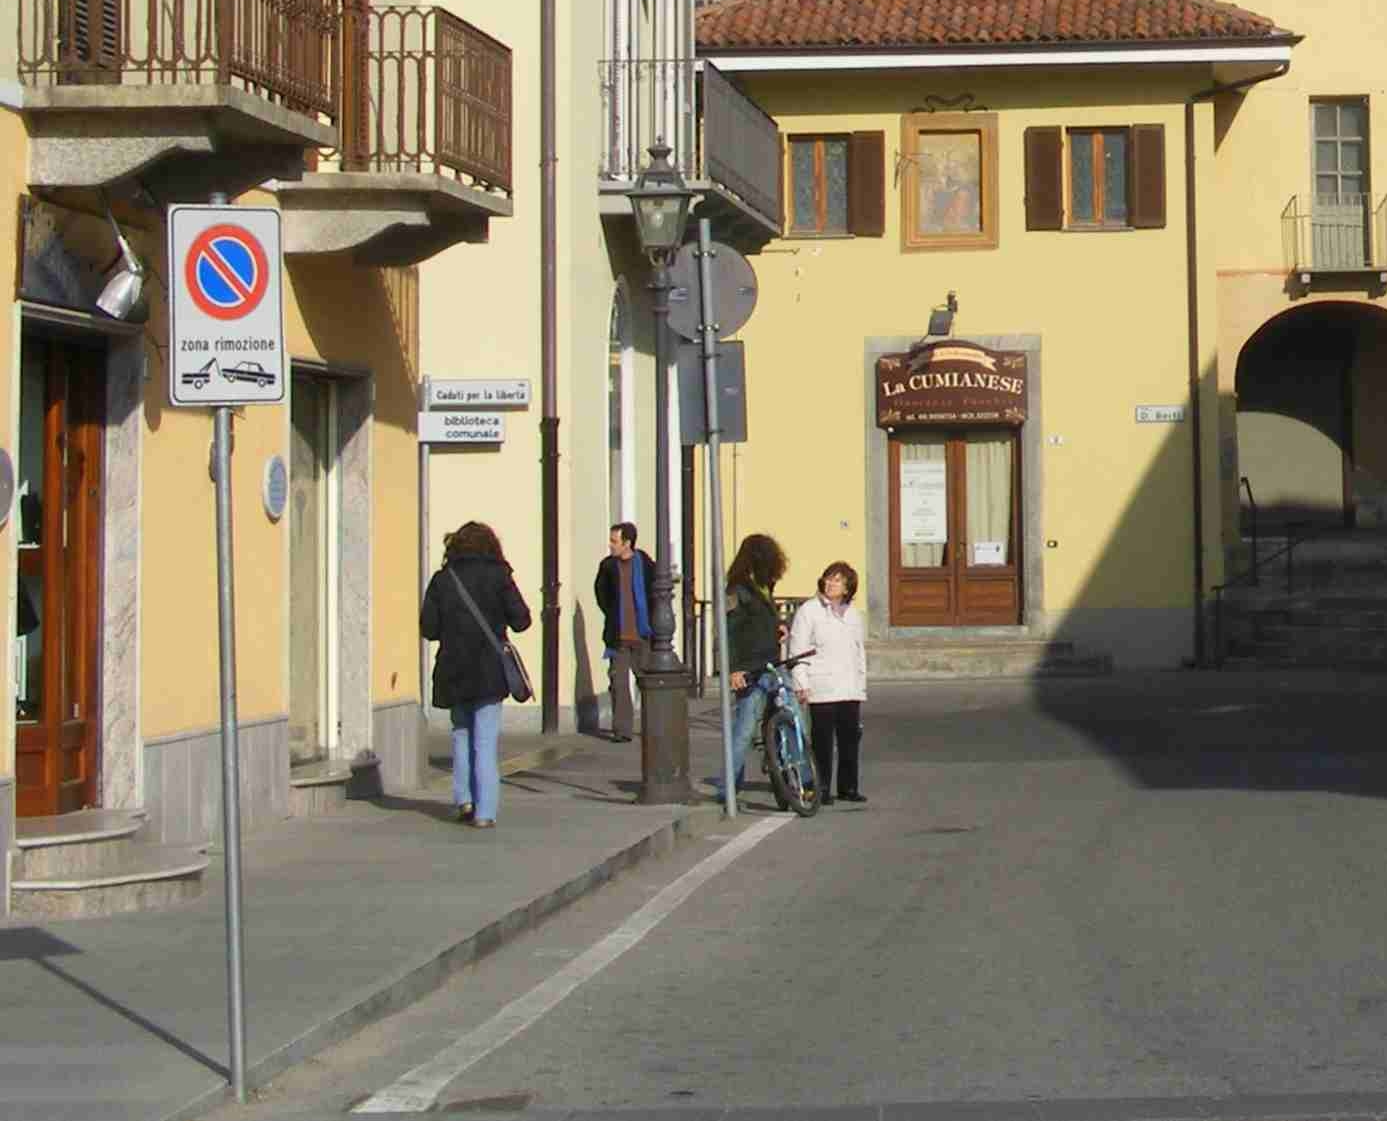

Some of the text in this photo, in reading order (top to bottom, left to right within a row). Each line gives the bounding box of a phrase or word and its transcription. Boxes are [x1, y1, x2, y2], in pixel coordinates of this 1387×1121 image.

[180, 336, 275, 351] zona rimozione
[883, 371, 1024, 397] La CUMIANESE
[466, 392, 480, 401] per
[484, 388, 493, 399] la
[443, 416, 500, 426] biblioteca
[445, 430, 499, 438] comunale
